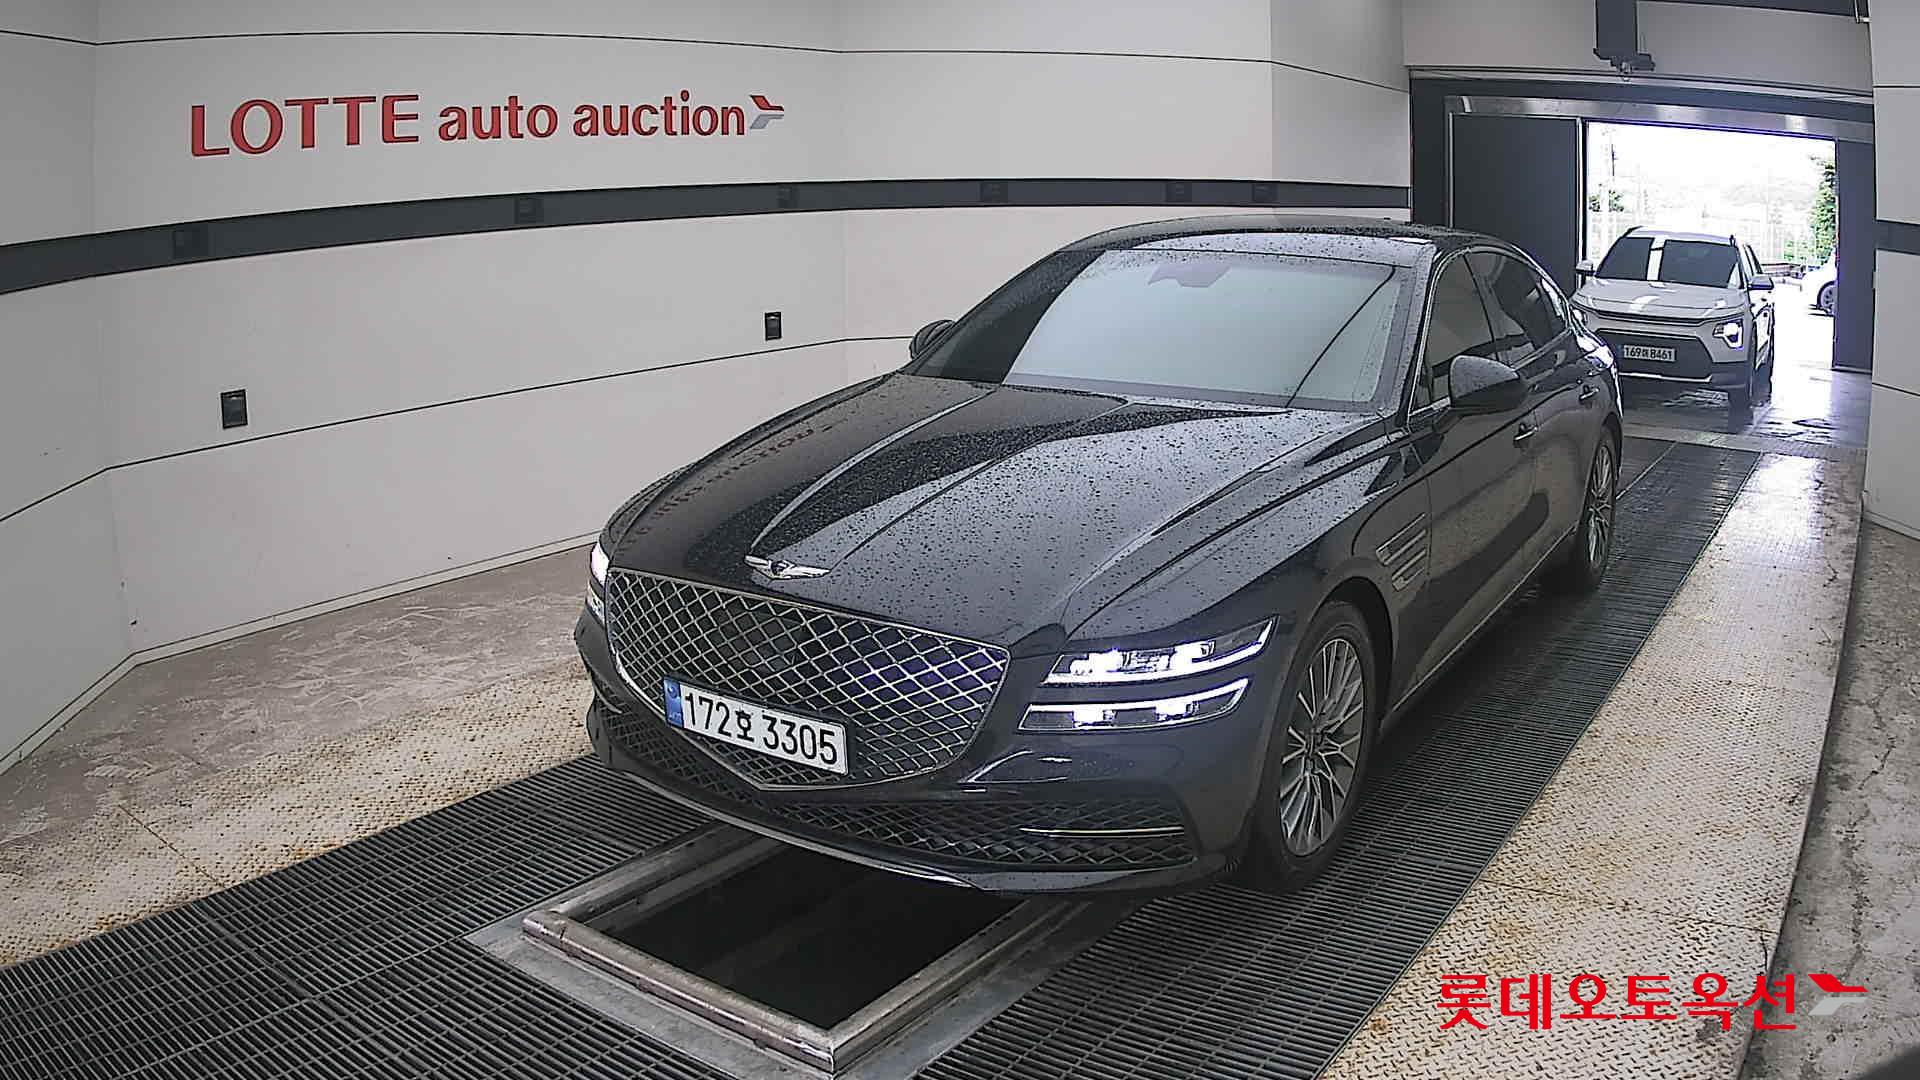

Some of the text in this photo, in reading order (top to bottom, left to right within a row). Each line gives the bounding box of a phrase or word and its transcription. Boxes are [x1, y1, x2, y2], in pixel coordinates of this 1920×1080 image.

[191, 89, 747, 158] LOTTE auto auction
[761, 713, 838, 765] 3305
